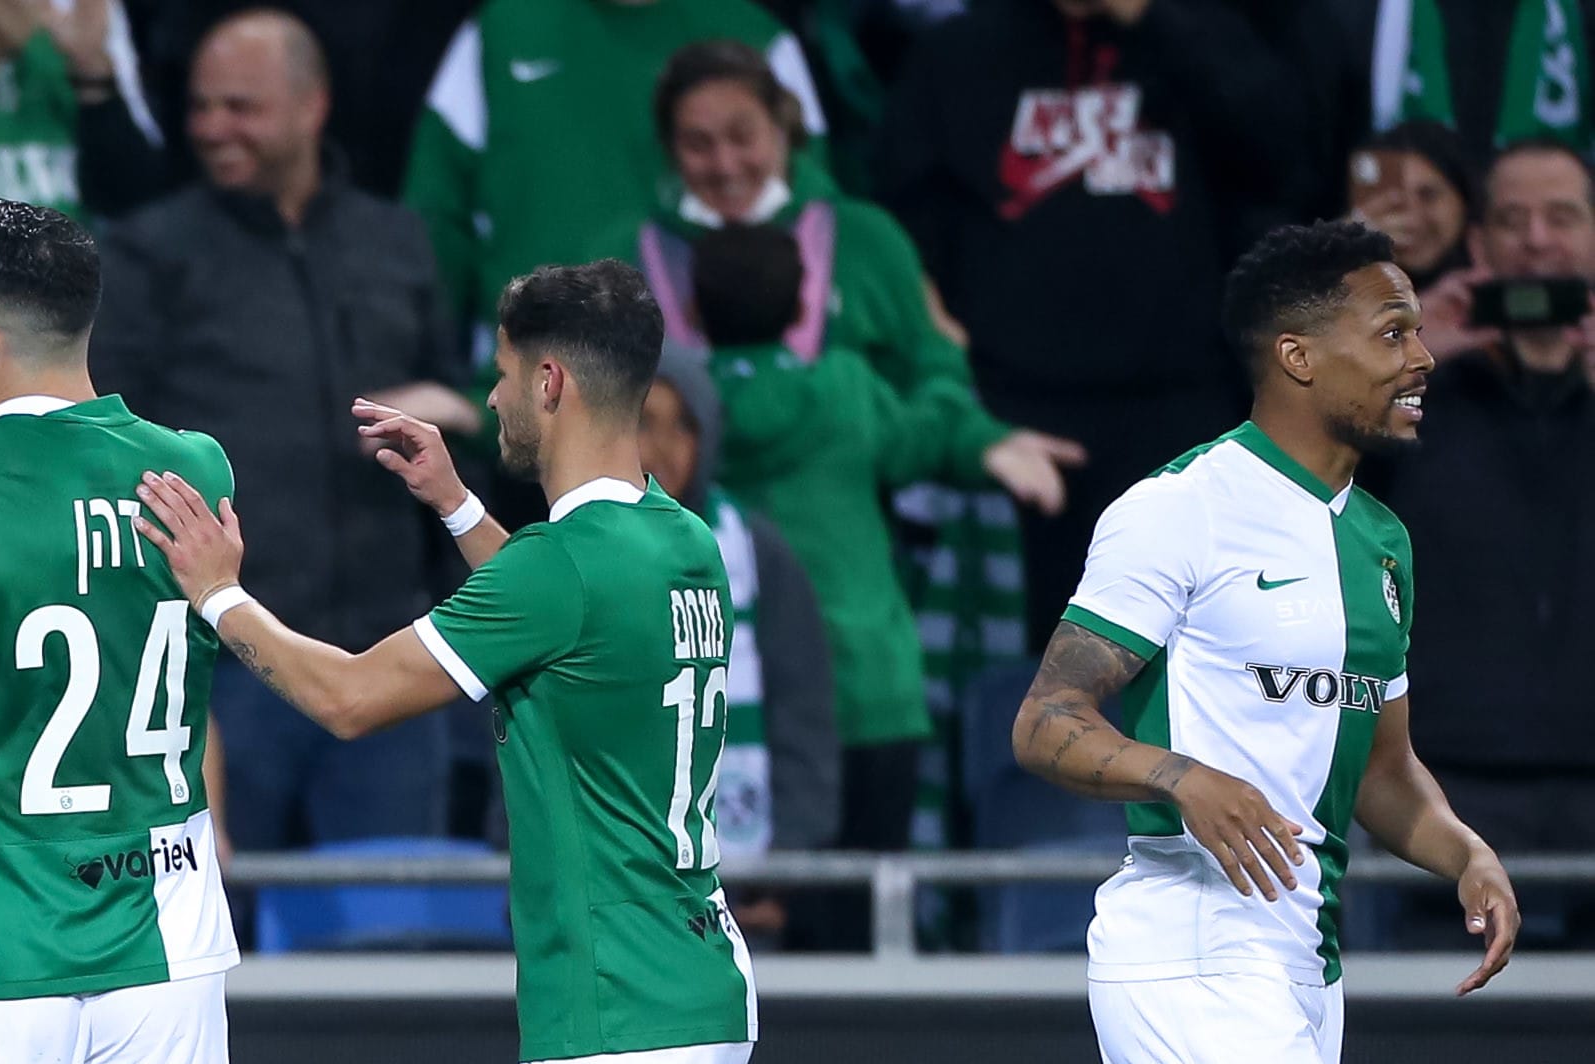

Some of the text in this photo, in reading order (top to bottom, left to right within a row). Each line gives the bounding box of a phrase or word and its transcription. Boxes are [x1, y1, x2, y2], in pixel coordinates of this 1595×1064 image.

[74, 498, 145, 595] דהן
[15, 600, 192, 814] 24
[1245, 662, 1389, 714] VOLV
[662, 666, 727, 870] 12
